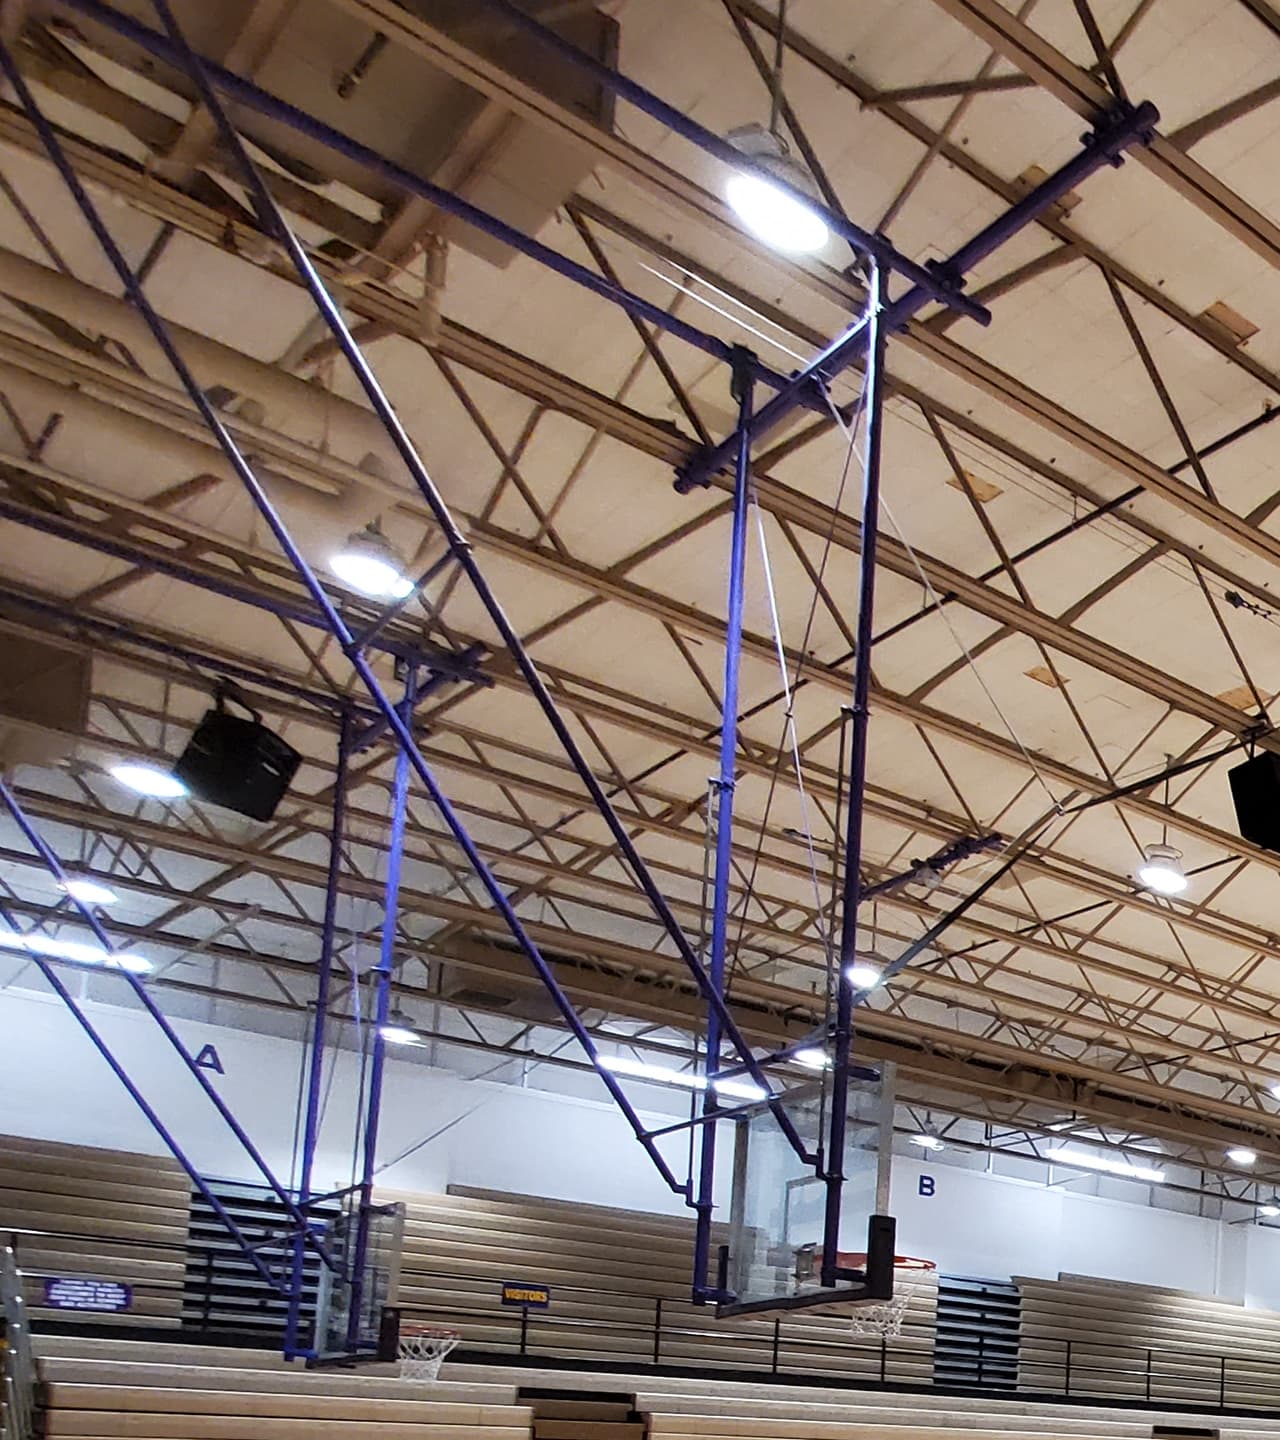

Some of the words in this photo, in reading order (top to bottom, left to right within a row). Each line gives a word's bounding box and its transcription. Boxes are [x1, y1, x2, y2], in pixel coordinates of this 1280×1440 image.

[195, 1044, 225, 1074] A
[919, 1174, 935, 1197] B
[505, 1288, 548, 1302] VISITORS
